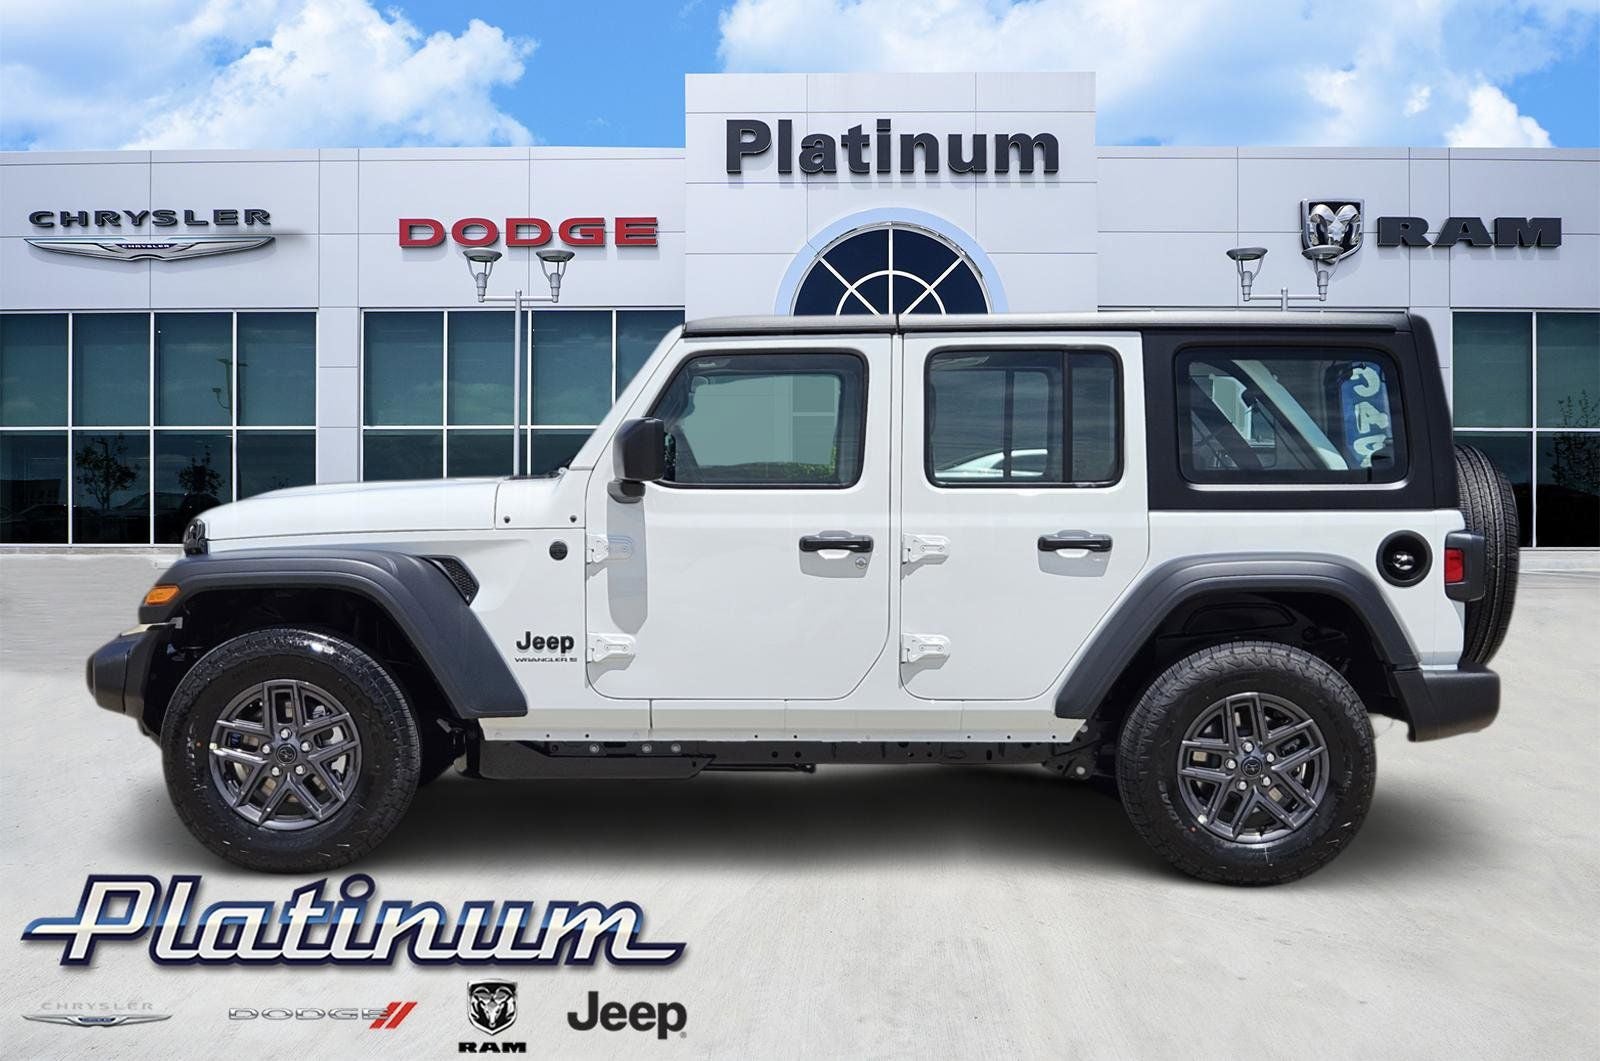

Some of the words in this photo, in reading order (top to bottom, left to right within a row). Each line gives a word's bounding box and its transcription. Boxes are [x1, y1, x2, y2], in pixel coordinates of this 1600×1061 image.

[726, 119, 1059, 174] Platinum
[28, 208, 271, 228] CHRYSLER
[398, 217, 658, 248] DODGE
[1377, 216, 1562, 248] RAM
[516, 631, 574, 654] Jeep
